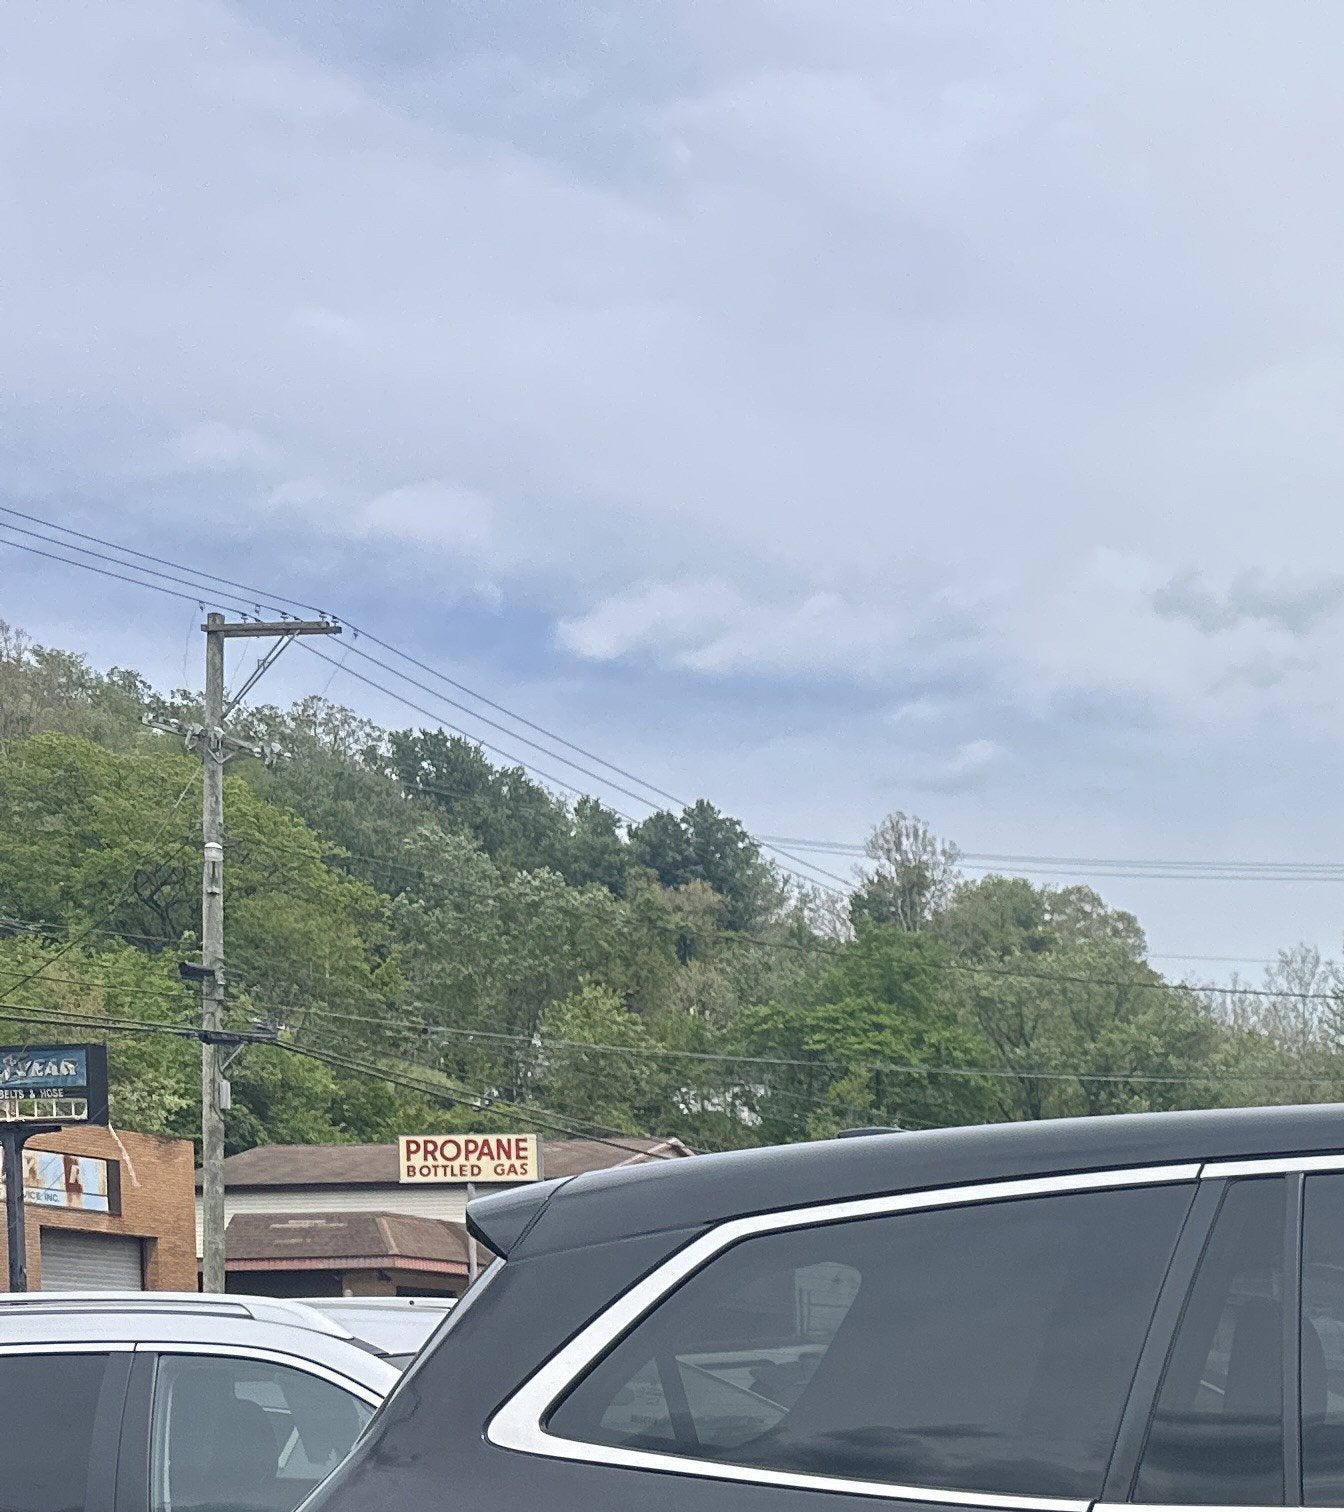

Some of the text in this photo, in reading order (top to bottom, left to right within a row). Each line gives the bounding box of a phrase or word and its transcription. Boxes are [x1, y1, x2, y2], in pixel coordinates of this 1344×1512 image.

[40, 1088, 63, 1099] HOSE
[405, 1138, 528, 1162] PROPANE
[406, 1163, 528, 1177] BOTTLED GAS
